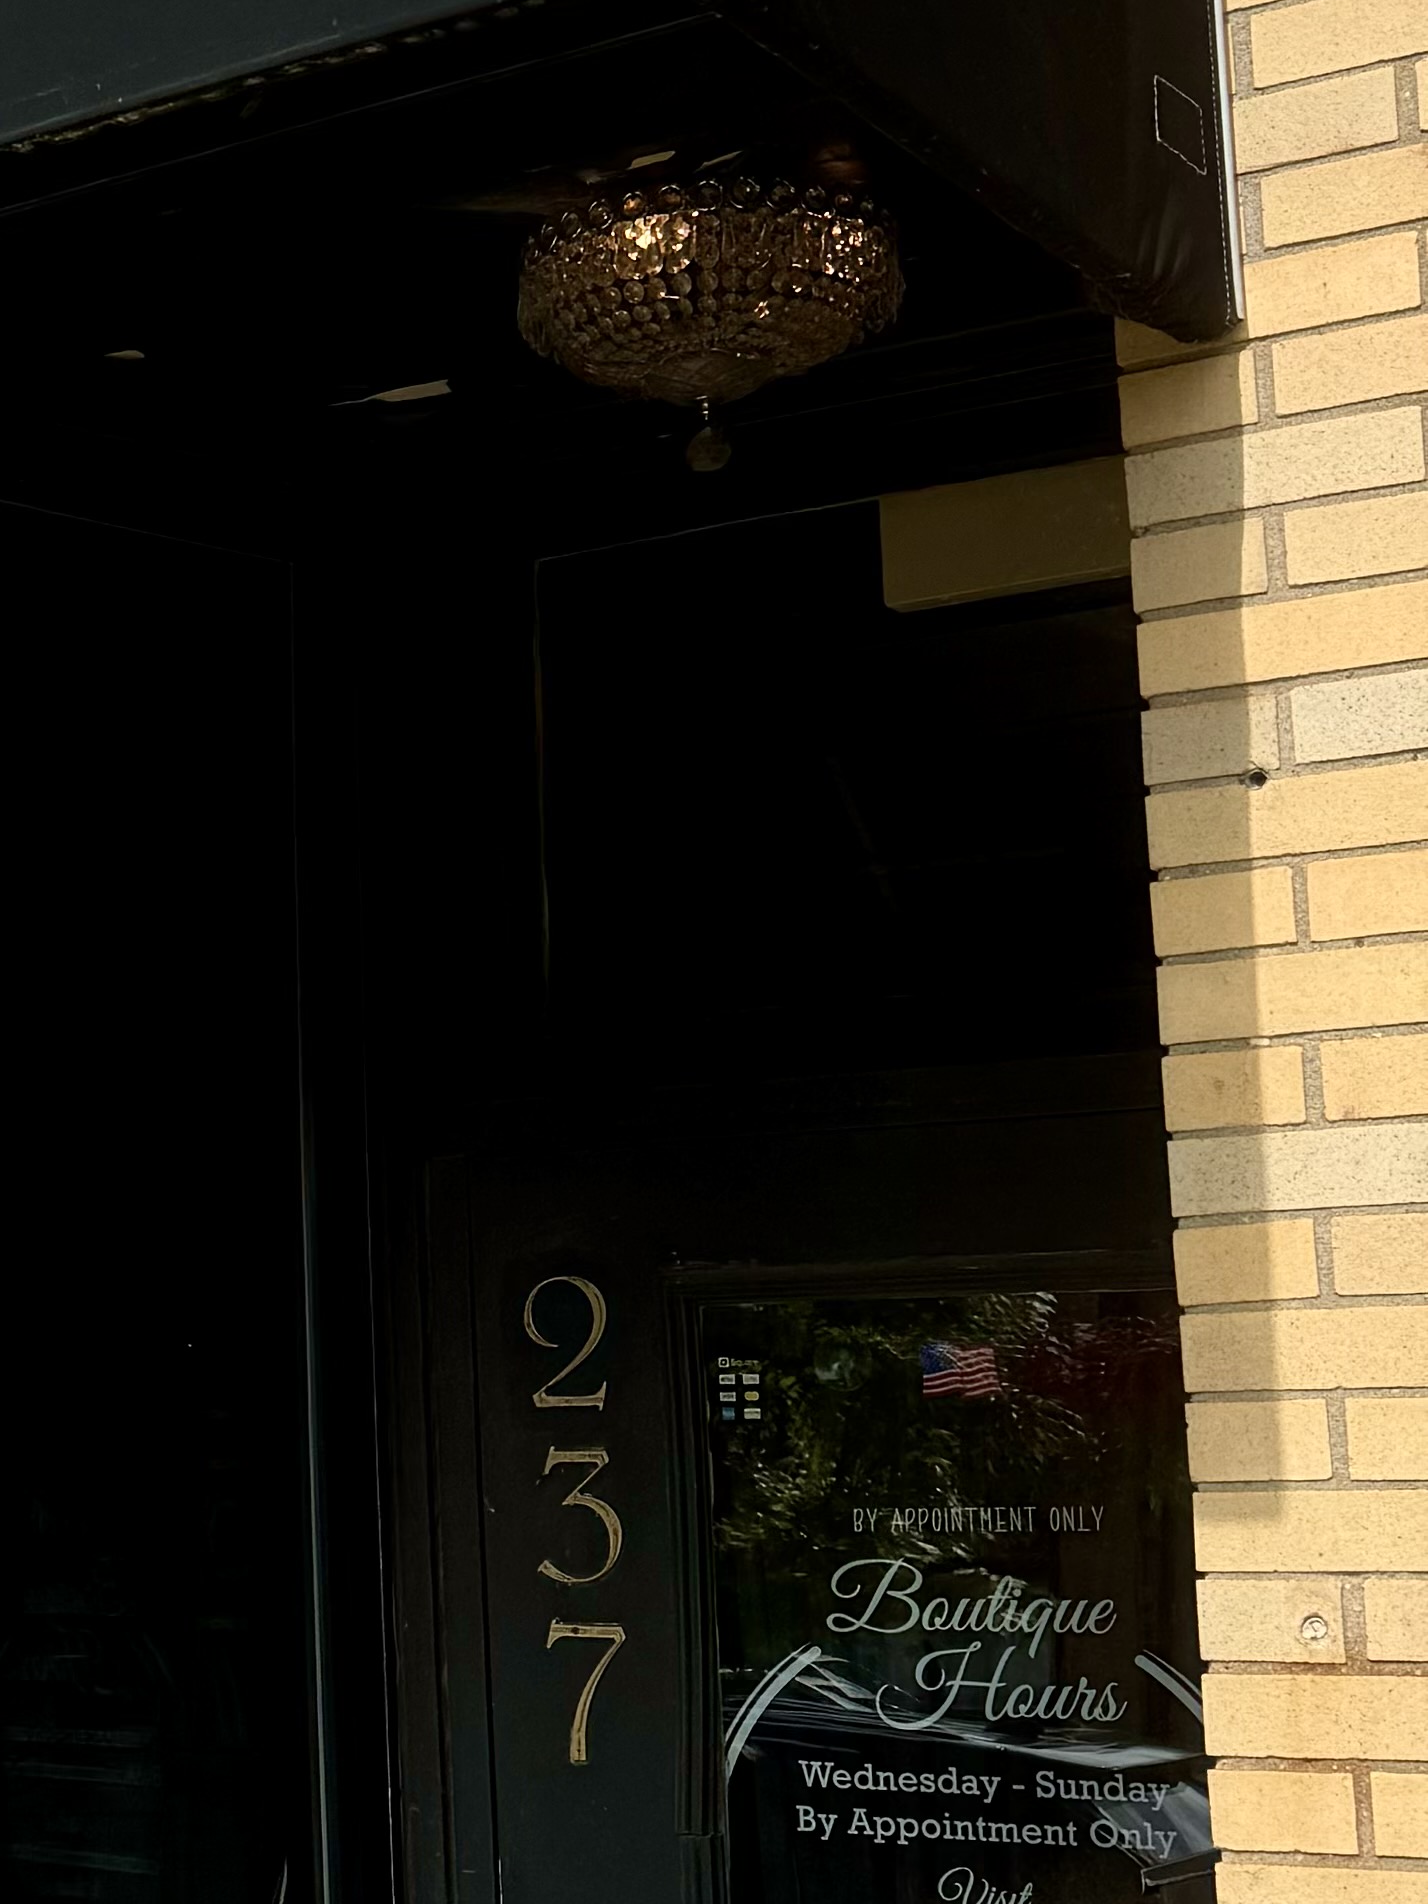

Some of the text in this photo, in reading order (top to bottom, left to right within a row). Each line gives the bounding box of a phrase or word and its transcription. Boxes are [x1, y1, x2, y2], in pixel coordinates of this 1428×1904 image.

[853, 1505, 1105, 1533] BY APPOINTMENT ONLY
[826, 1557, 1118, 1660] Boutique
[874, 1640, 1129, 1731] Hours
[797, 1759, 1002, 1804] Wednesday
[1034, 1770, 1170, 1811] Sunday
[795, 1805, 1178, 1859] By Appointment Only
